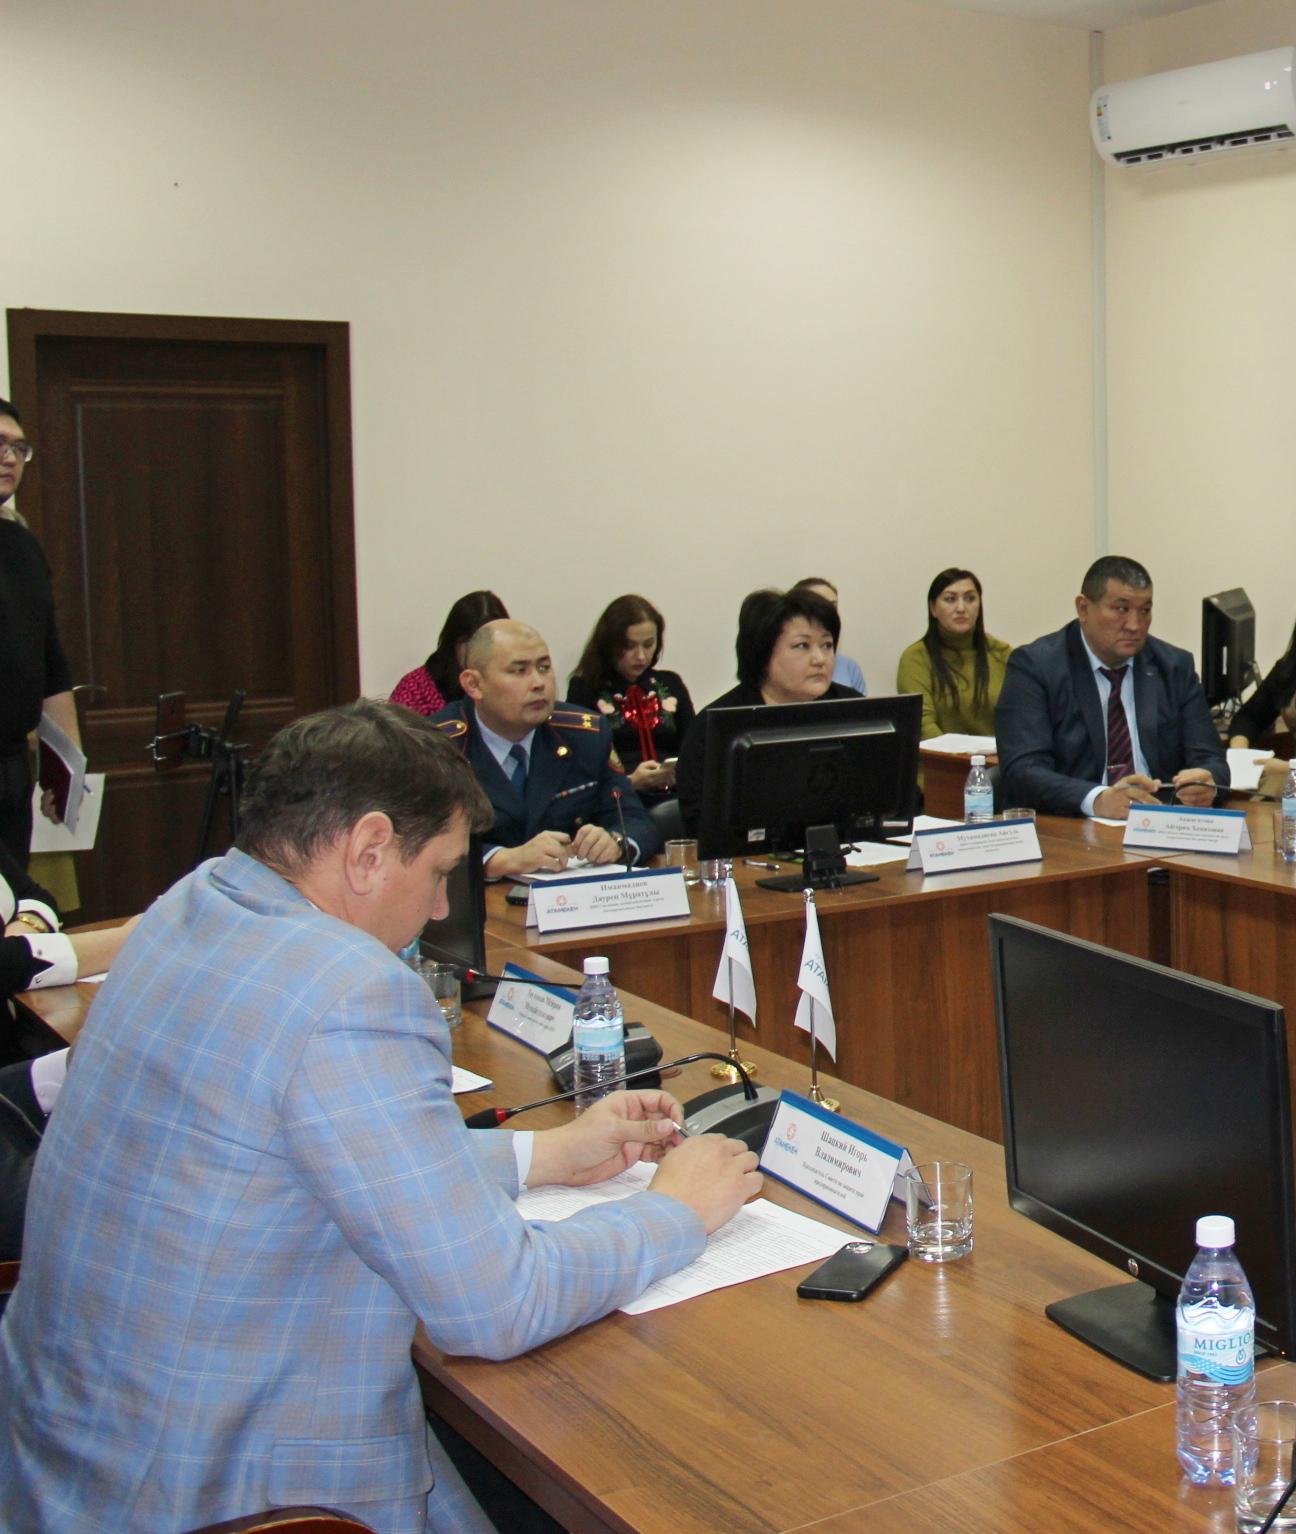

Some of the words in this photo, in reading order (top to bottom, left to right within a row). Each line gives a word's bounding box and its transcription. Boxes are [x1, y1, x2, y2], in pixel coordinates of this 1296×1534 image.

[815, 1146, 862, 1178] Владимирович
[820, 1130, 848, 1152] Шацкий
[847, 1144, 868, 1163] Игорь
[1194, 1332, 1251, 1351] MIGLIO
